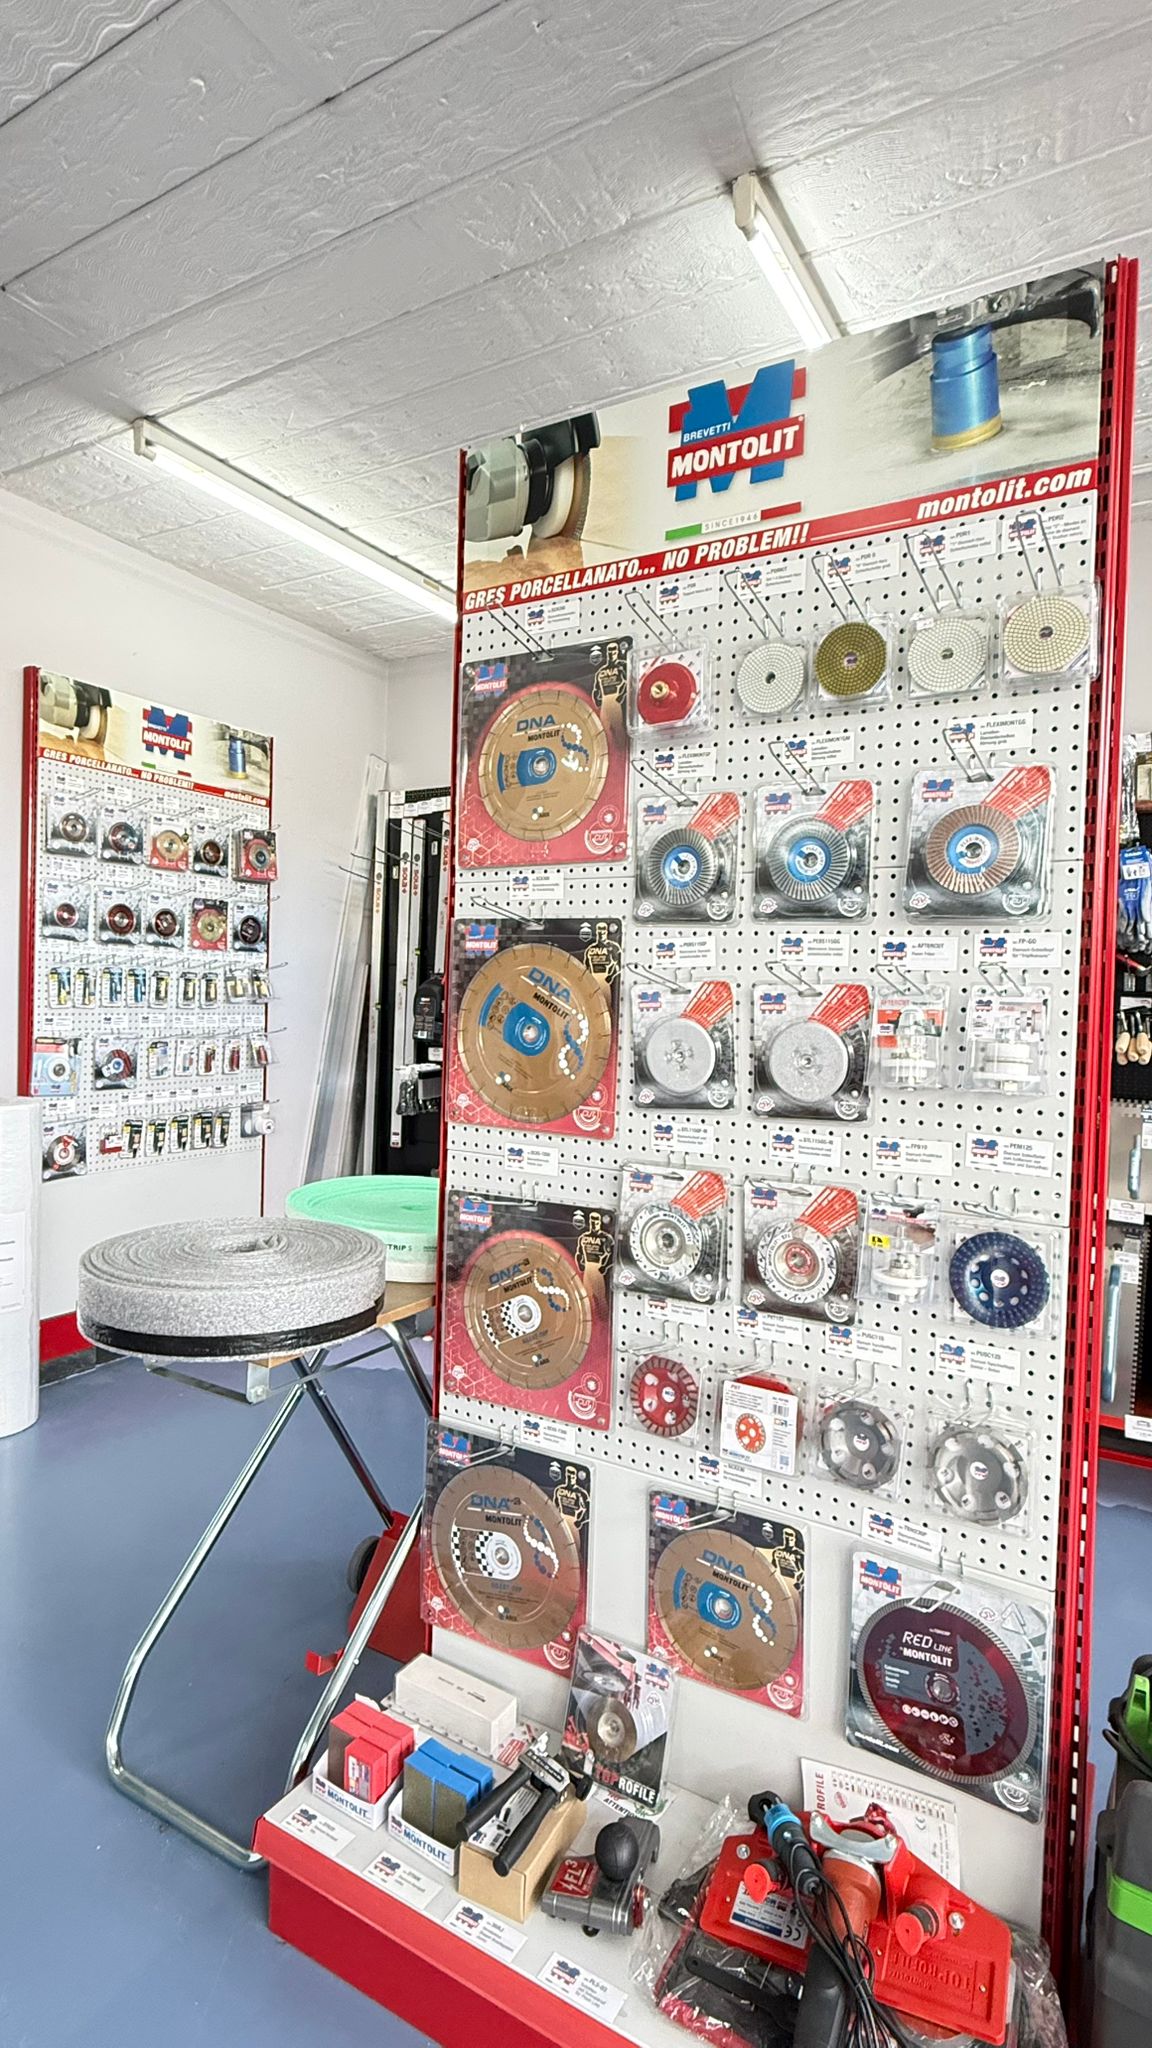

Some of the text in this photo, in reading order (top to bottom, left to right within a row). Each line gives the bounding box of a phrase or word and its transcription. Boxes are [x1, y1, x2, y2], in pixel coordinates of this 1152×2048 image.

[683, 421, 731, 443] BREVETTI
[671, 425, 800, 479] MONTOLIT
[917, 467, 1093, 520] montolit.com
[465, 523, 810, 610] GRES PORCELLANATO... NO PROBLEM!!
[517, 714, 556, 732] DNA
[528, 729, 561, 742] MONTOLIT
[143, 730, 191, 751] MONTOLIT
[43, 749, 68, 761] GRES
[140, 770, 152, 781] NO
[528, 967, 571, 1004] DNA
[533, 991, 569, 1020] MONTOLIT
[485, 1514, 522, 1527] MONTOLIT
[703, 1549, 746, 1577] DNA
[712, 1570, 749, 1591] MONTOLIT
[861, 1575, 900, 1594] MONTOLIT
[902, 1631, 933, 1648] RED
[903, 1648, 953, 1667] MONTOLIT
[327, 1789, 368, 1819] MONTOLIT
[404, 1829, 447, 1862] MONTOLIT
